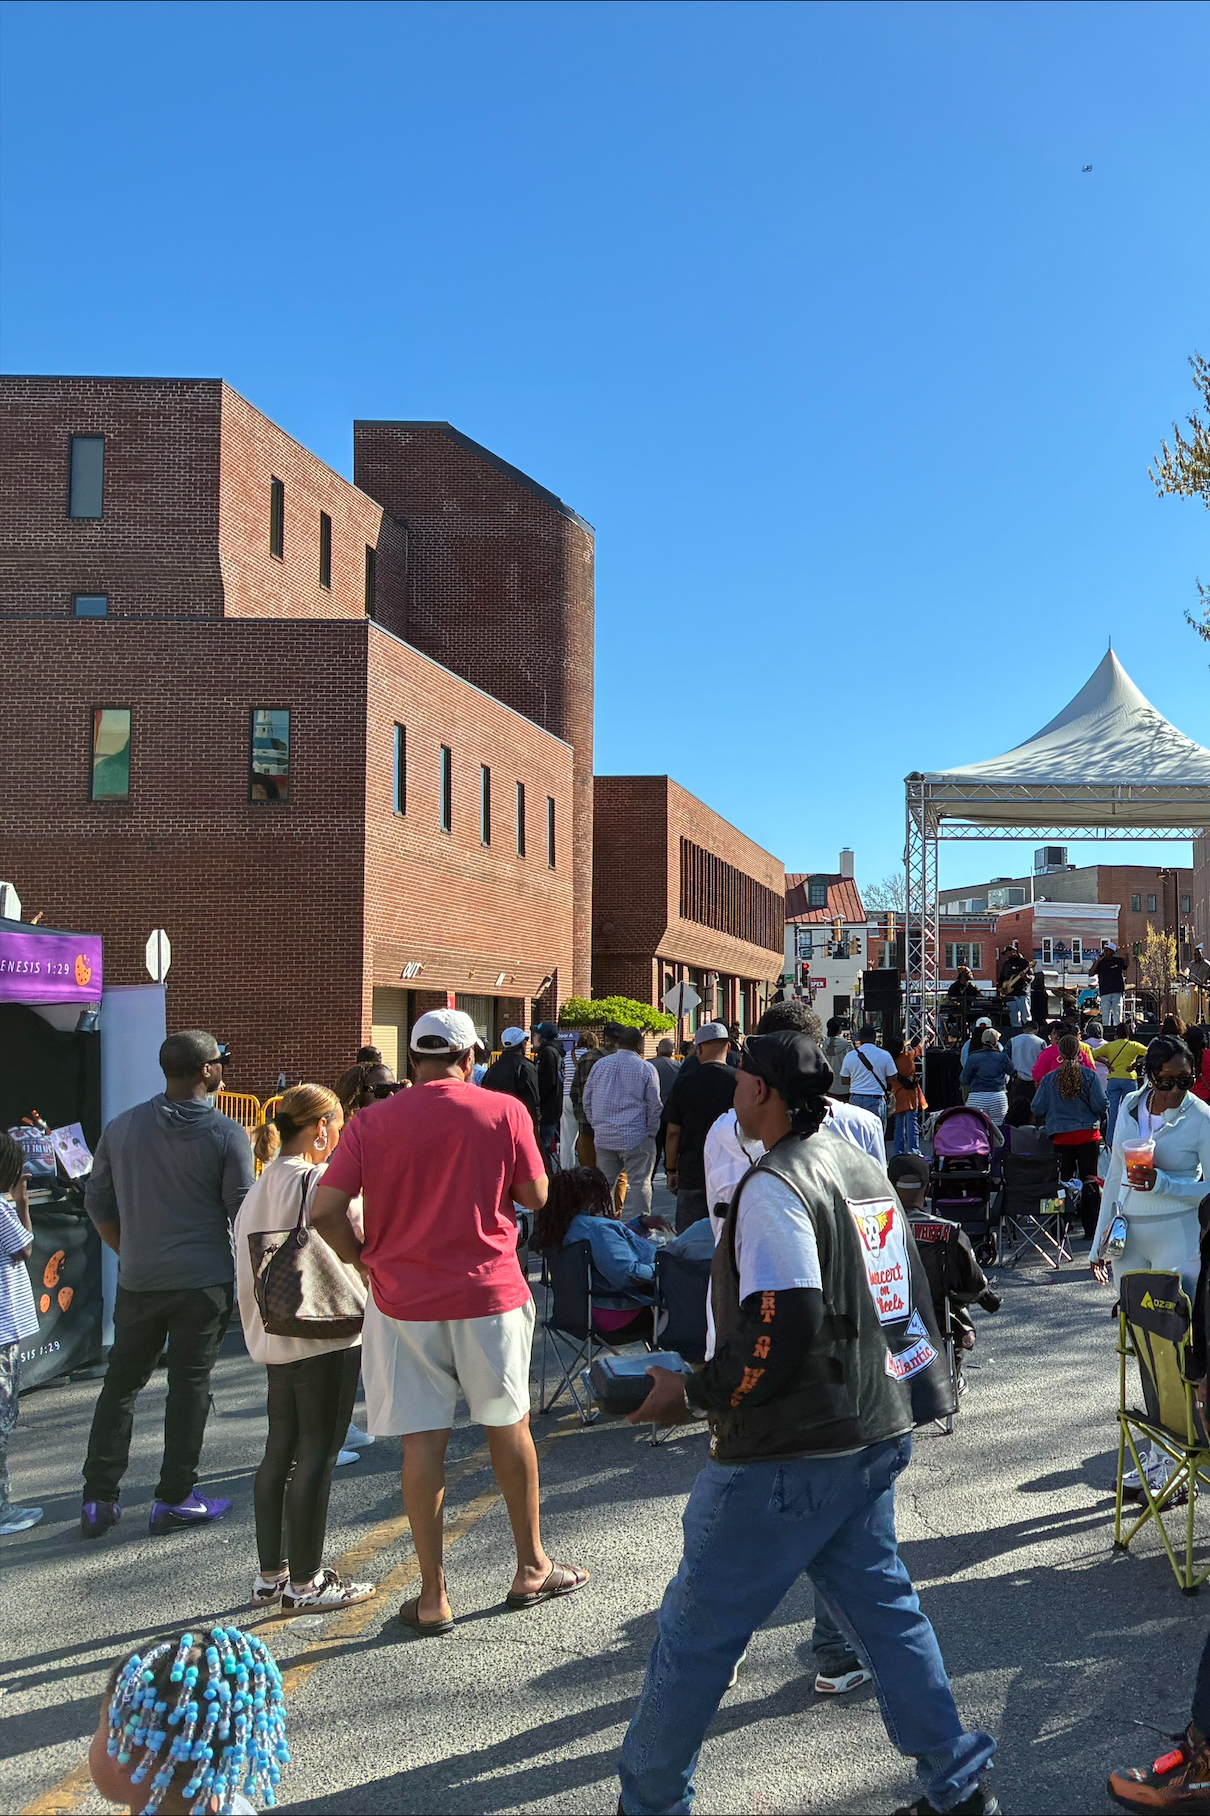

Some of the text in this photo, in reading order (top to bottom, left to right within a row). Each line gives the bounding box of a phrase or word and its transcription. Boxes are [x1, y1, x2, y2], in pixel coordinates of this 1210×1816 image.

[47, 962, 70, 975] 1:29
[403, 961, 421, 979] OUT
[914, 1223, 950, 1243] WHEES
[880, 1285, 891, 1296] on
[40, 1340, 61, 1356] 1:29
[753, 1335, 771, 1360] ON
